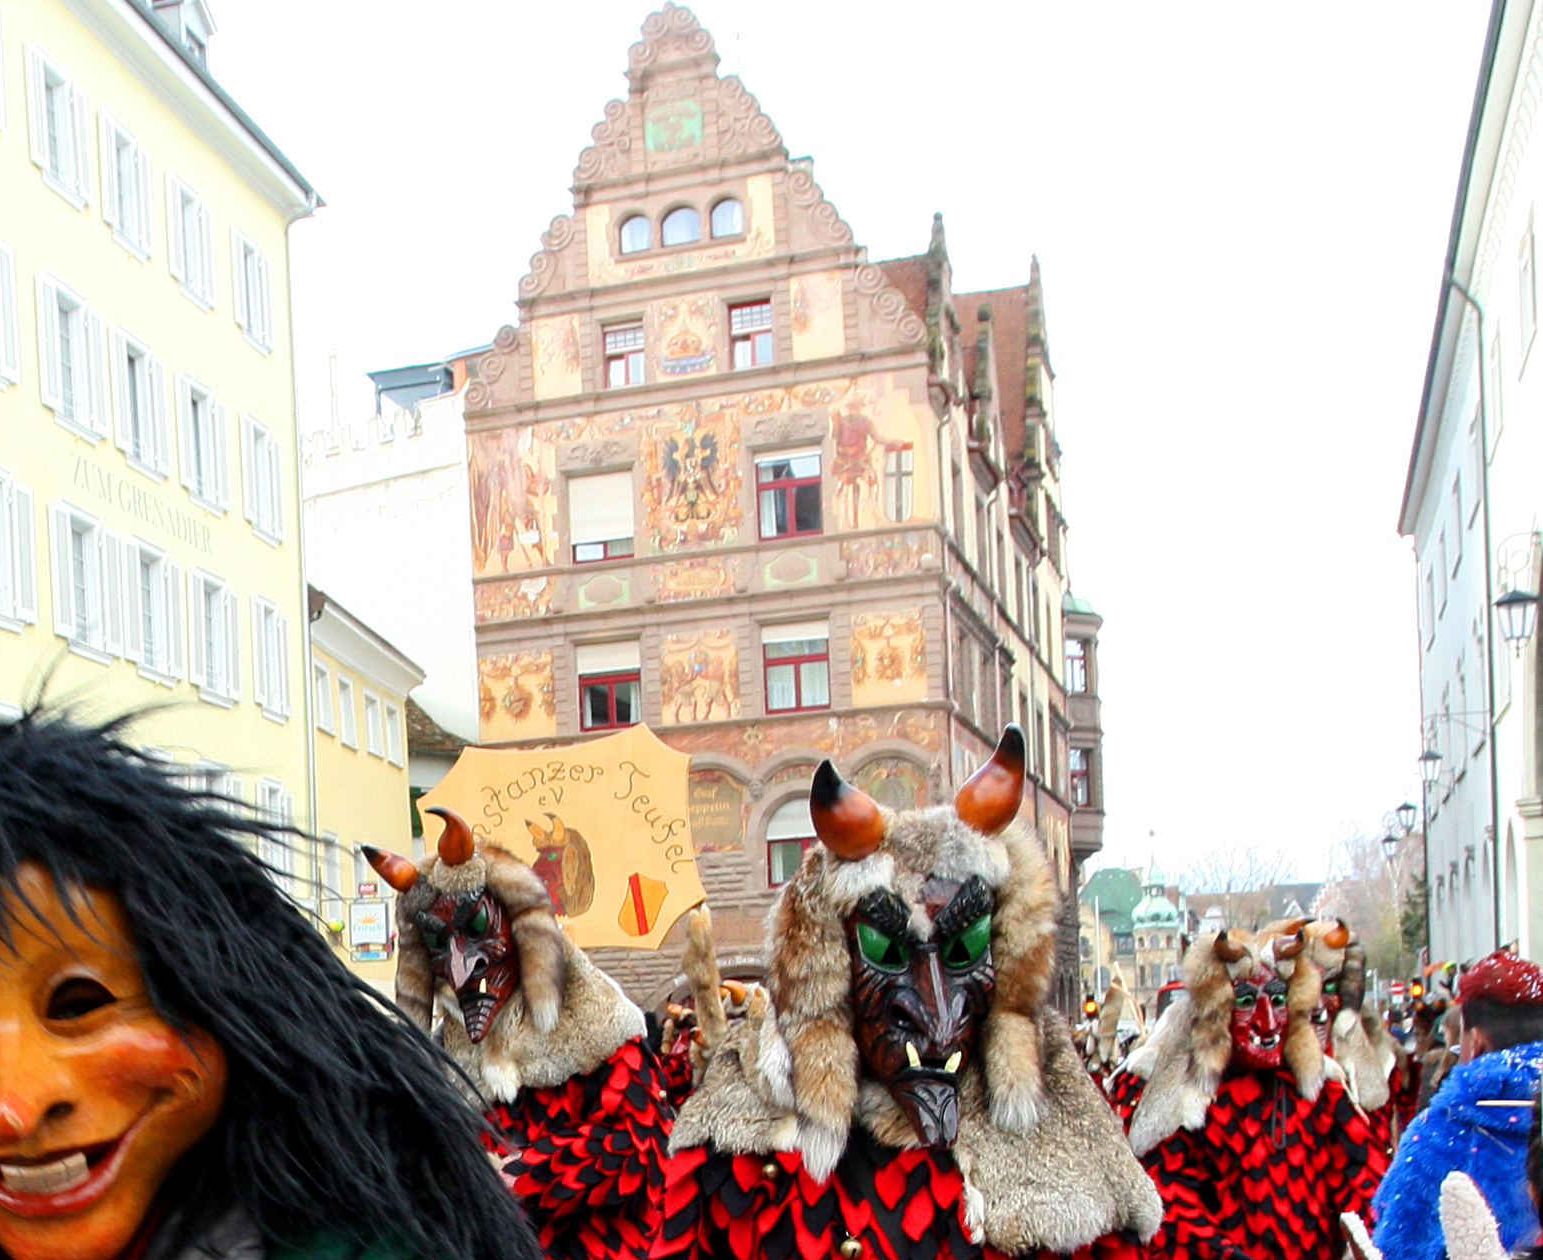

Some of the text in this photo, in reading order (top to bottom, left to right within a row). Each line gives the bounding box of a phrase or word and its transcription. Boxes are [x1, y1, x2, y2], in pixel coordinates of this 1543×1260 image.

[70, 453, 213, 555] ZUM GRENADIER
[472, 761, 604, 838] nstanzer
[690, 802, 730, 815] eppelin
